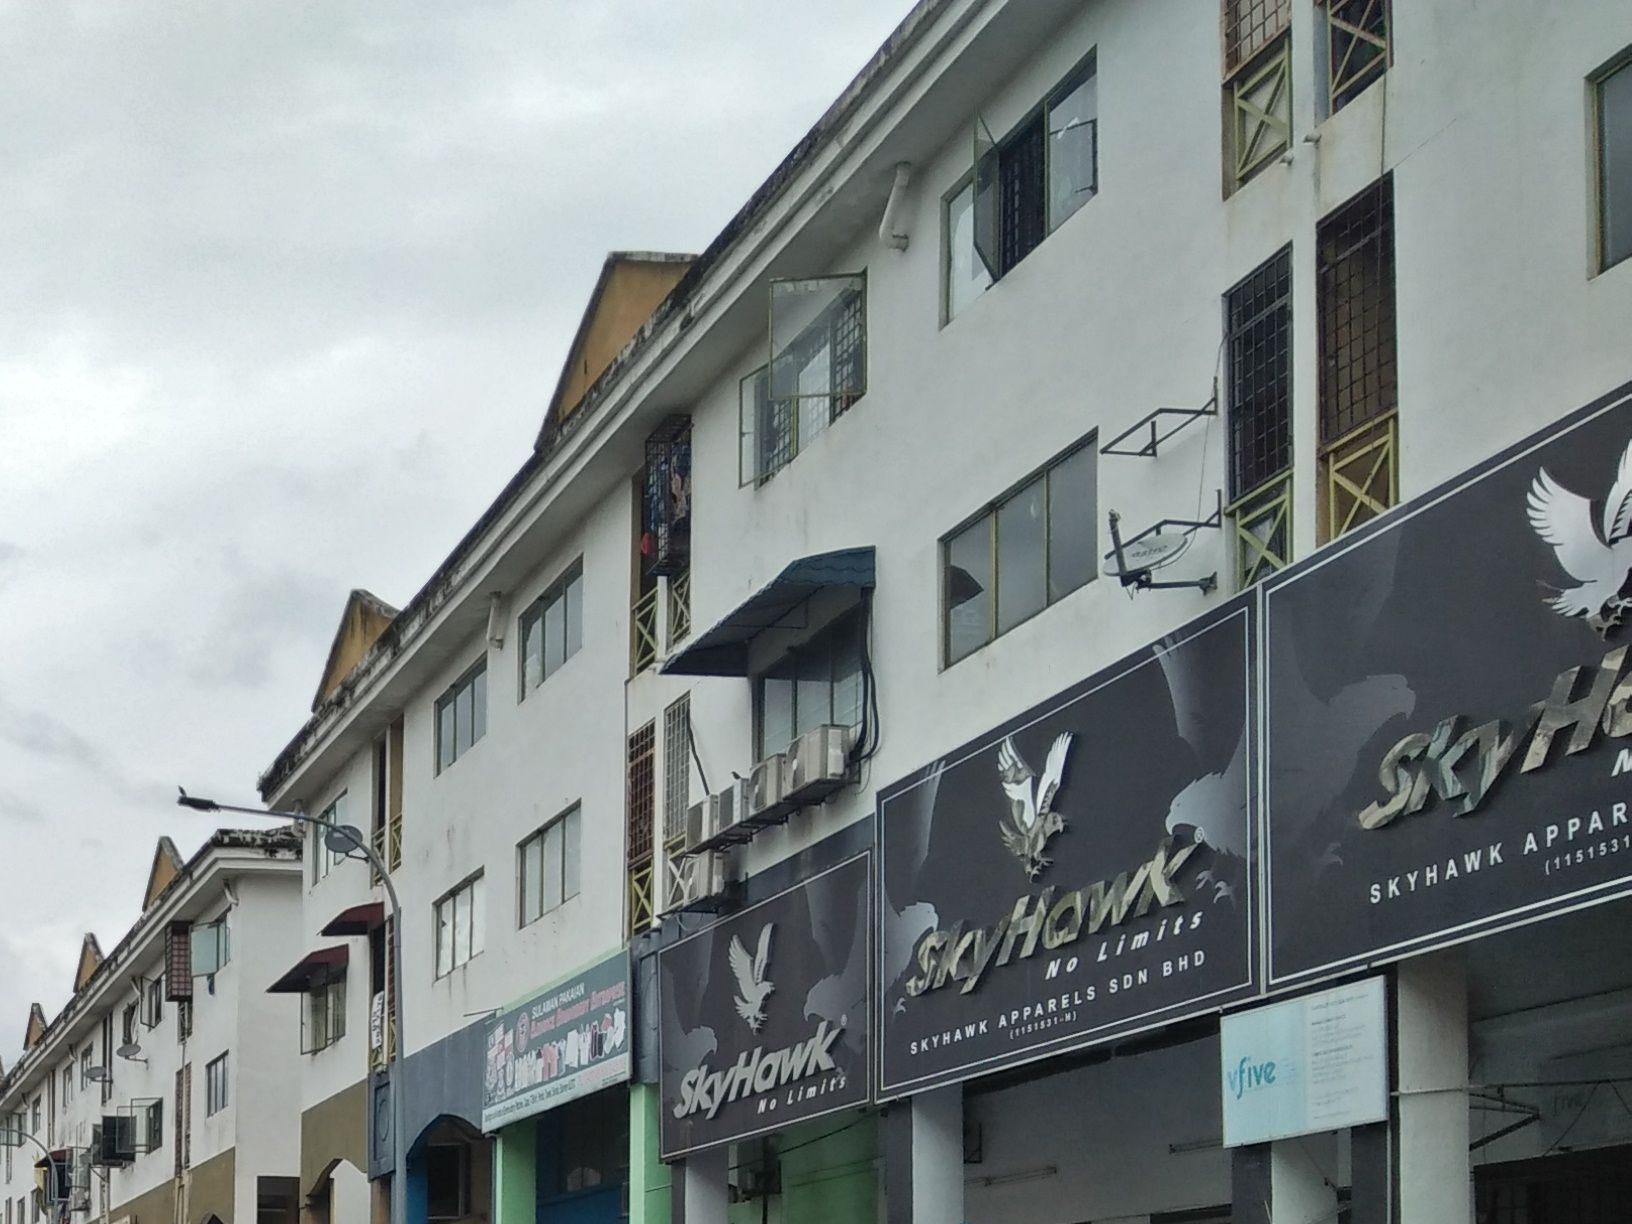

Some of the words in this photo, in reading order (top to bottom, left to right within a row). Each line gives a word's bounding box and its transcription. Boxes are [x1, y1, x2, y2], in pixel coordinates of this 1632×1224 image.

[1370, 842, 1504, 904] SKYHAWK
[905, 838, 1199, 997] SkyHawk
[1045, 955, 1077, 981] No
[1097, 911, 1204, 963] Limits
[910, 1020, 989, 1055] SKYHAWK
[998, 986, 1097, 1029] APPARELS
[1108, 968, 1148, 994] SDN
[1163, 950, 1206, 978] BHD
[673, 1019, 846, 1120] SkyHawk
[757, 1097, 777, 1115] No
[786, 1074, 847, 1106] Limits
[1228, 1056, 1276, 1100] vfive
